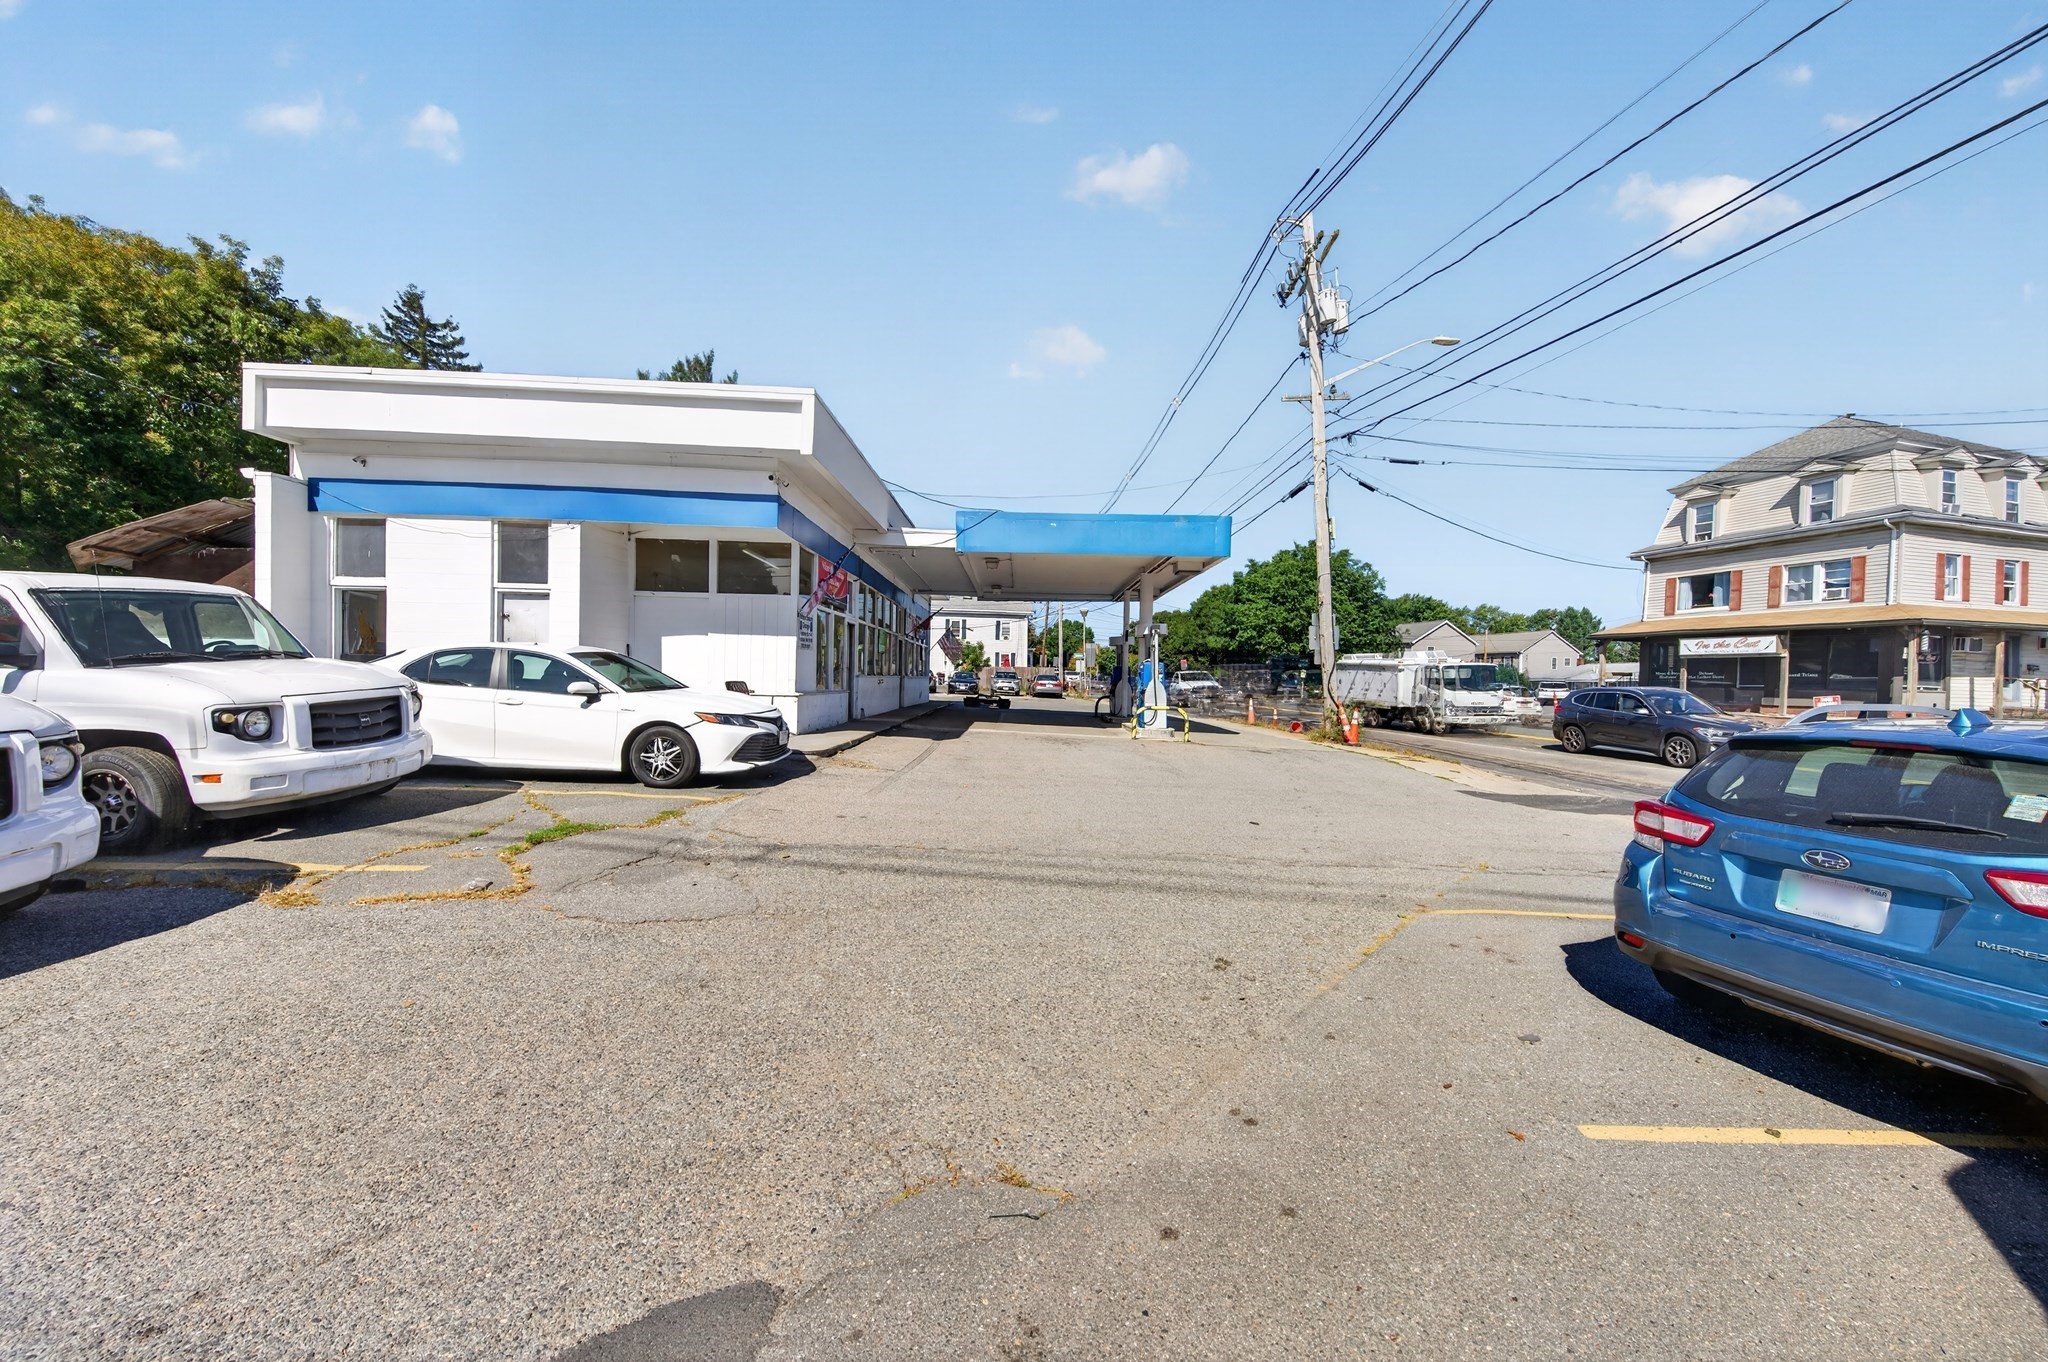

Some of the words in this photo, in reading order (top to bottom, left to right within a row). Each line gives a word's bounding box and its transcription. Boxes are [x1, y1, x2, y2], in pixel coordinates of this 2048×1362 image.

[1694, 640, 1711, 650] In
[1713, 640, 1731, 649] the
[1672, 867, 1716, 883] SUBARU
